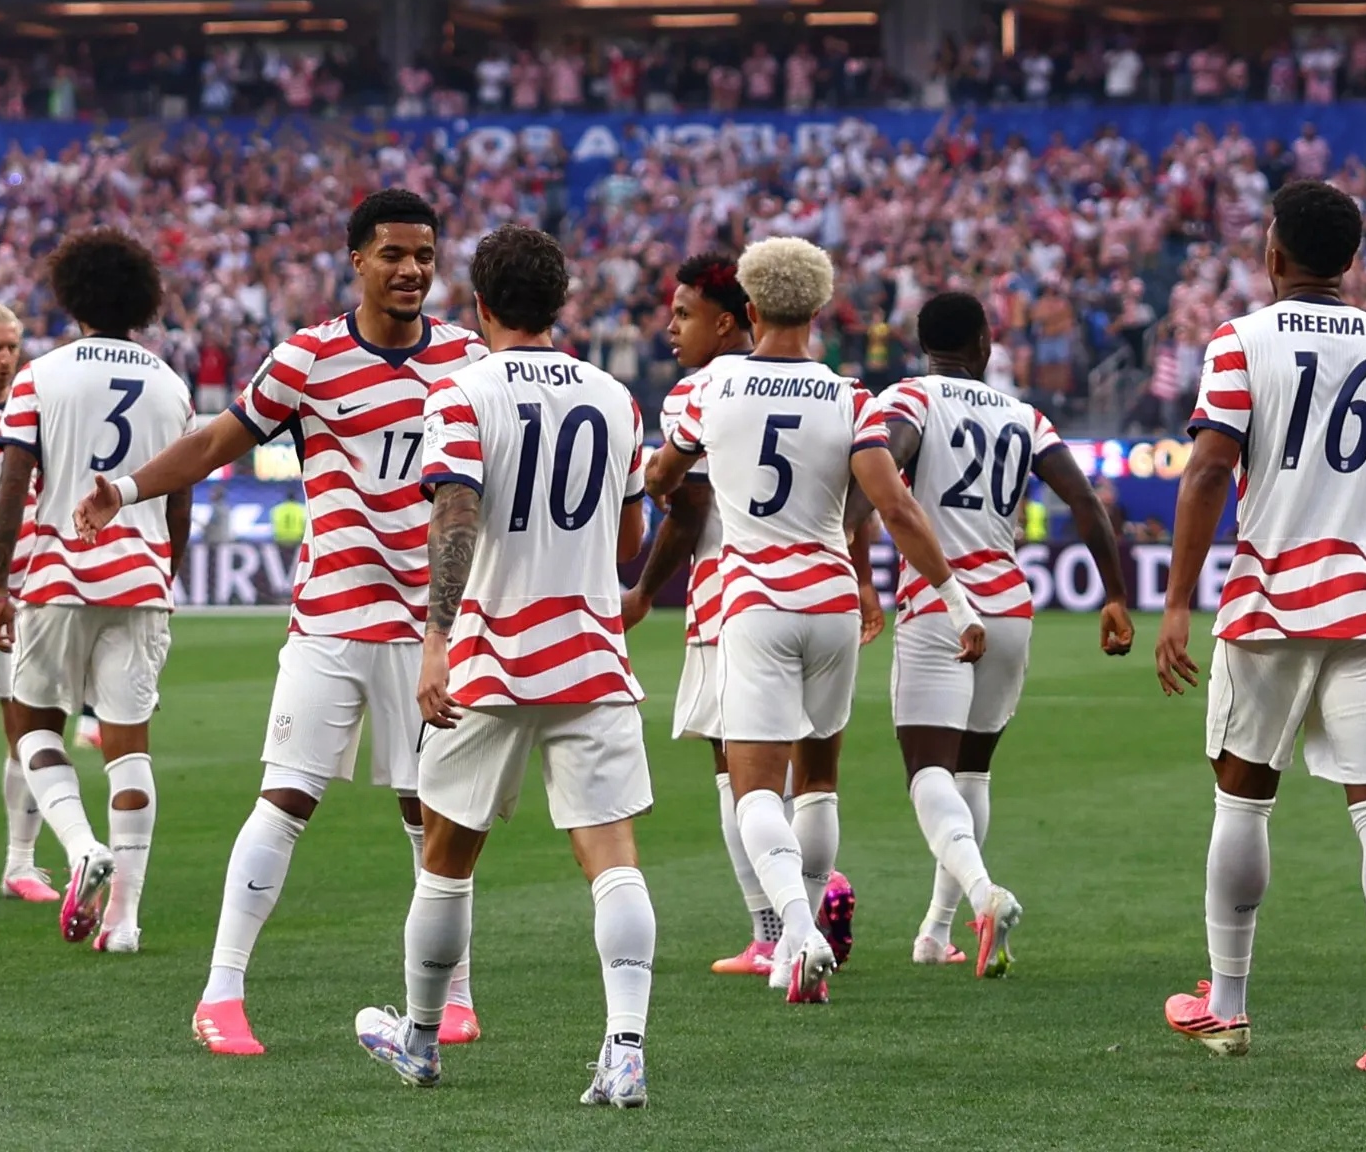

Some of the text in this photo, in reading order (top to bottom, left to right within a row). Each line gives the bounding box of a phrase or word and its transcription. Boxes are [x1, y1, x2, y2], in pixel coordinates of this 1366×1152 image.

[76, 346, 161, 370] RICHARDS
[505, 361, 583, 386] PULISIC
[743, 376, 841, 402] ROBINSON
[90, 377, 145, 472] 3
[378, 430, 424, 480] 17
[508, 402, 609, 532] 10
[749, 414, 802, 517] 5
[939, 416, 1032, 518] 20
